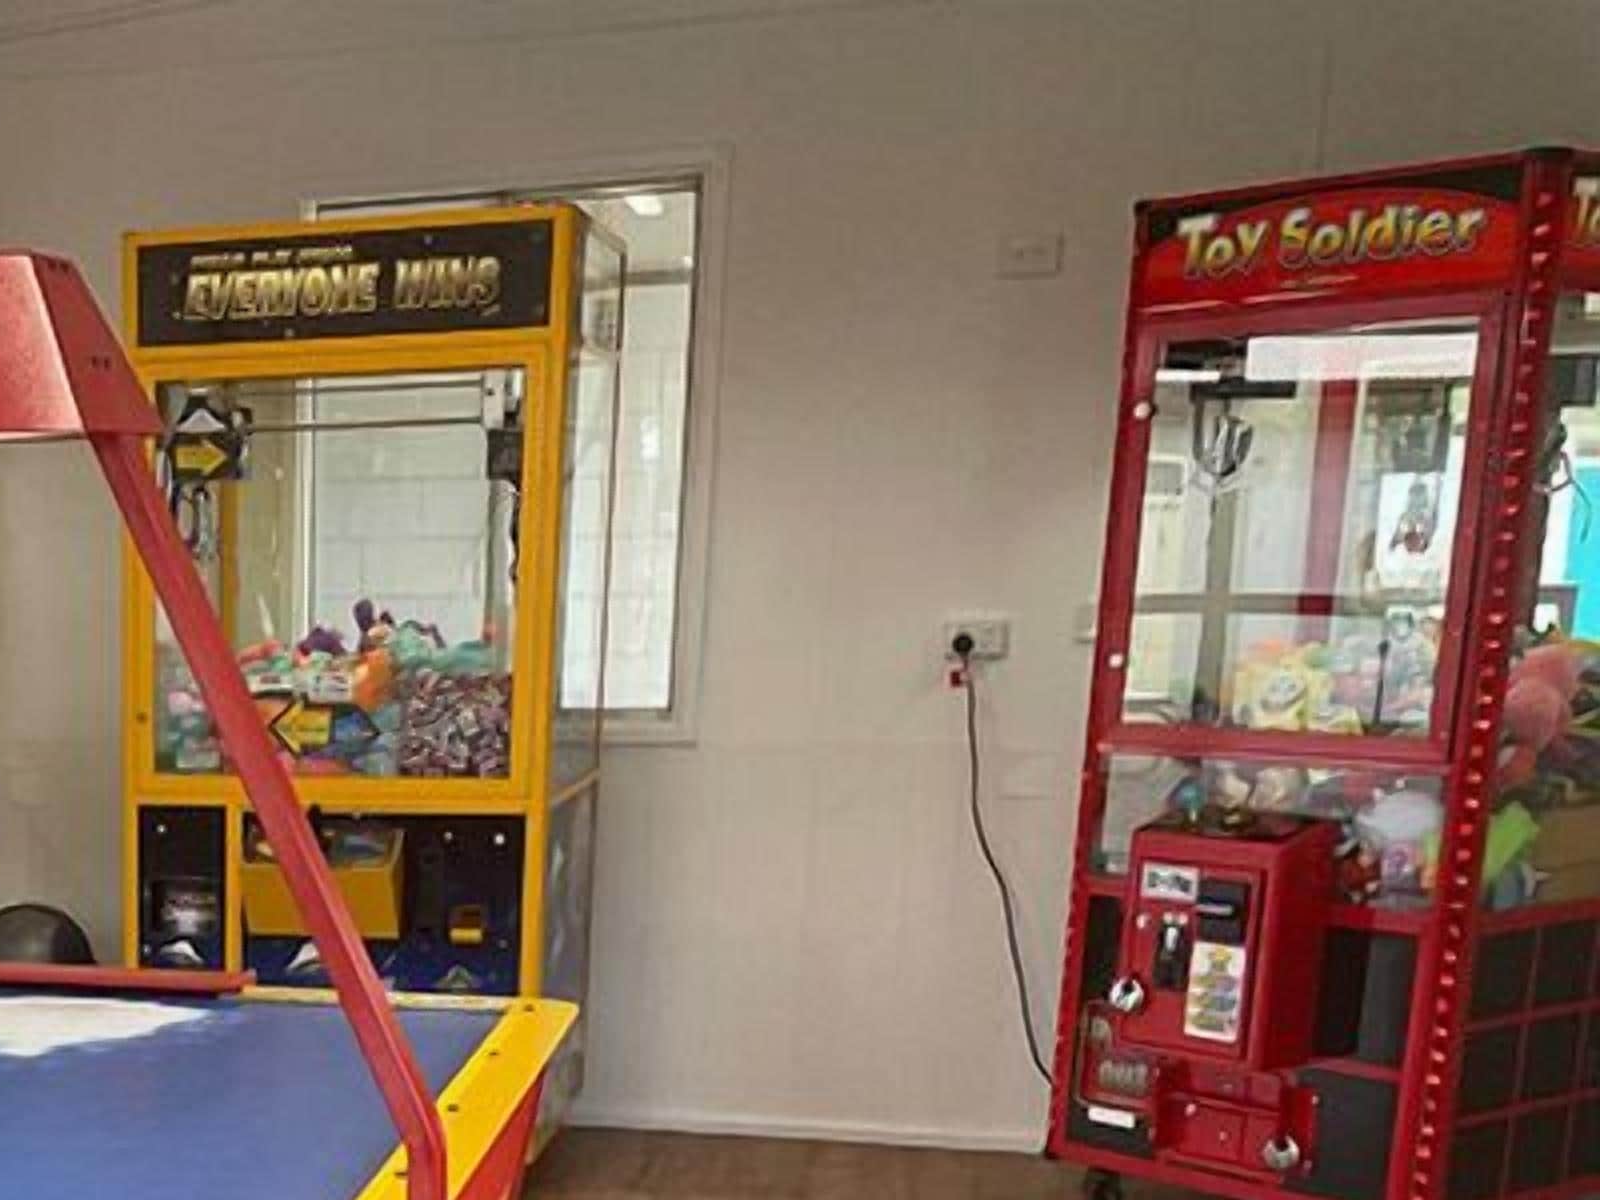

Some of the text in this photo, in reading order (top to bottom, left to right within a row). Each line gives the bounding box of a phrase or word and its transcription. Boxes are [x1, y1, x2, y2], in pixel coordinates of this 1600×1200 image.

[1178, 204, 1487, 280] Toy Soldier
[184, 255, 502, 320] EVERYONE WINS
